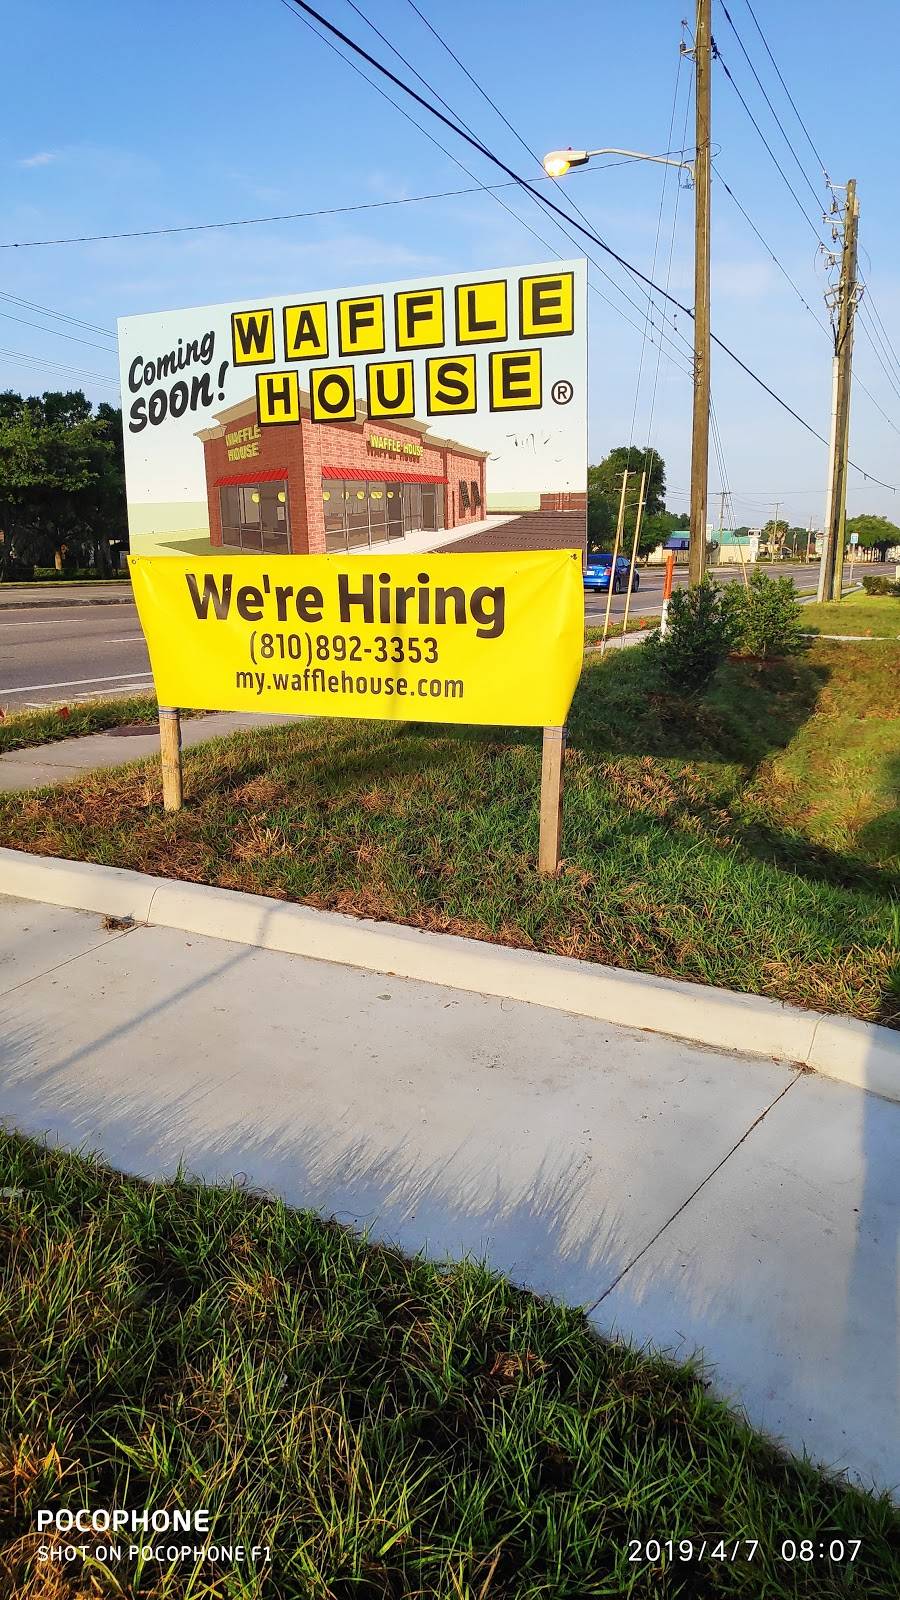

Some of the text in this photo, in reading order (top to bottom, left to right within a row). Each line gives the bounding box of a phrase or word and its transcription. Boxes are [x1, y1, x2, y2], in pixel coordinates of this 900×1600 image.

[233, 277, 568, 360] WAFFLE
[128, 330, 216, 394] Coming
[264, 353, 535, 419] HOUSE
[370, 434, 424, 457] WAFFLE HOUSE
[185, 572, 506, 639] We're Hiring
[249, 631, 439, 667] (810)892-3353
[236, 668, 464, 698] my.wafflehouse.com
